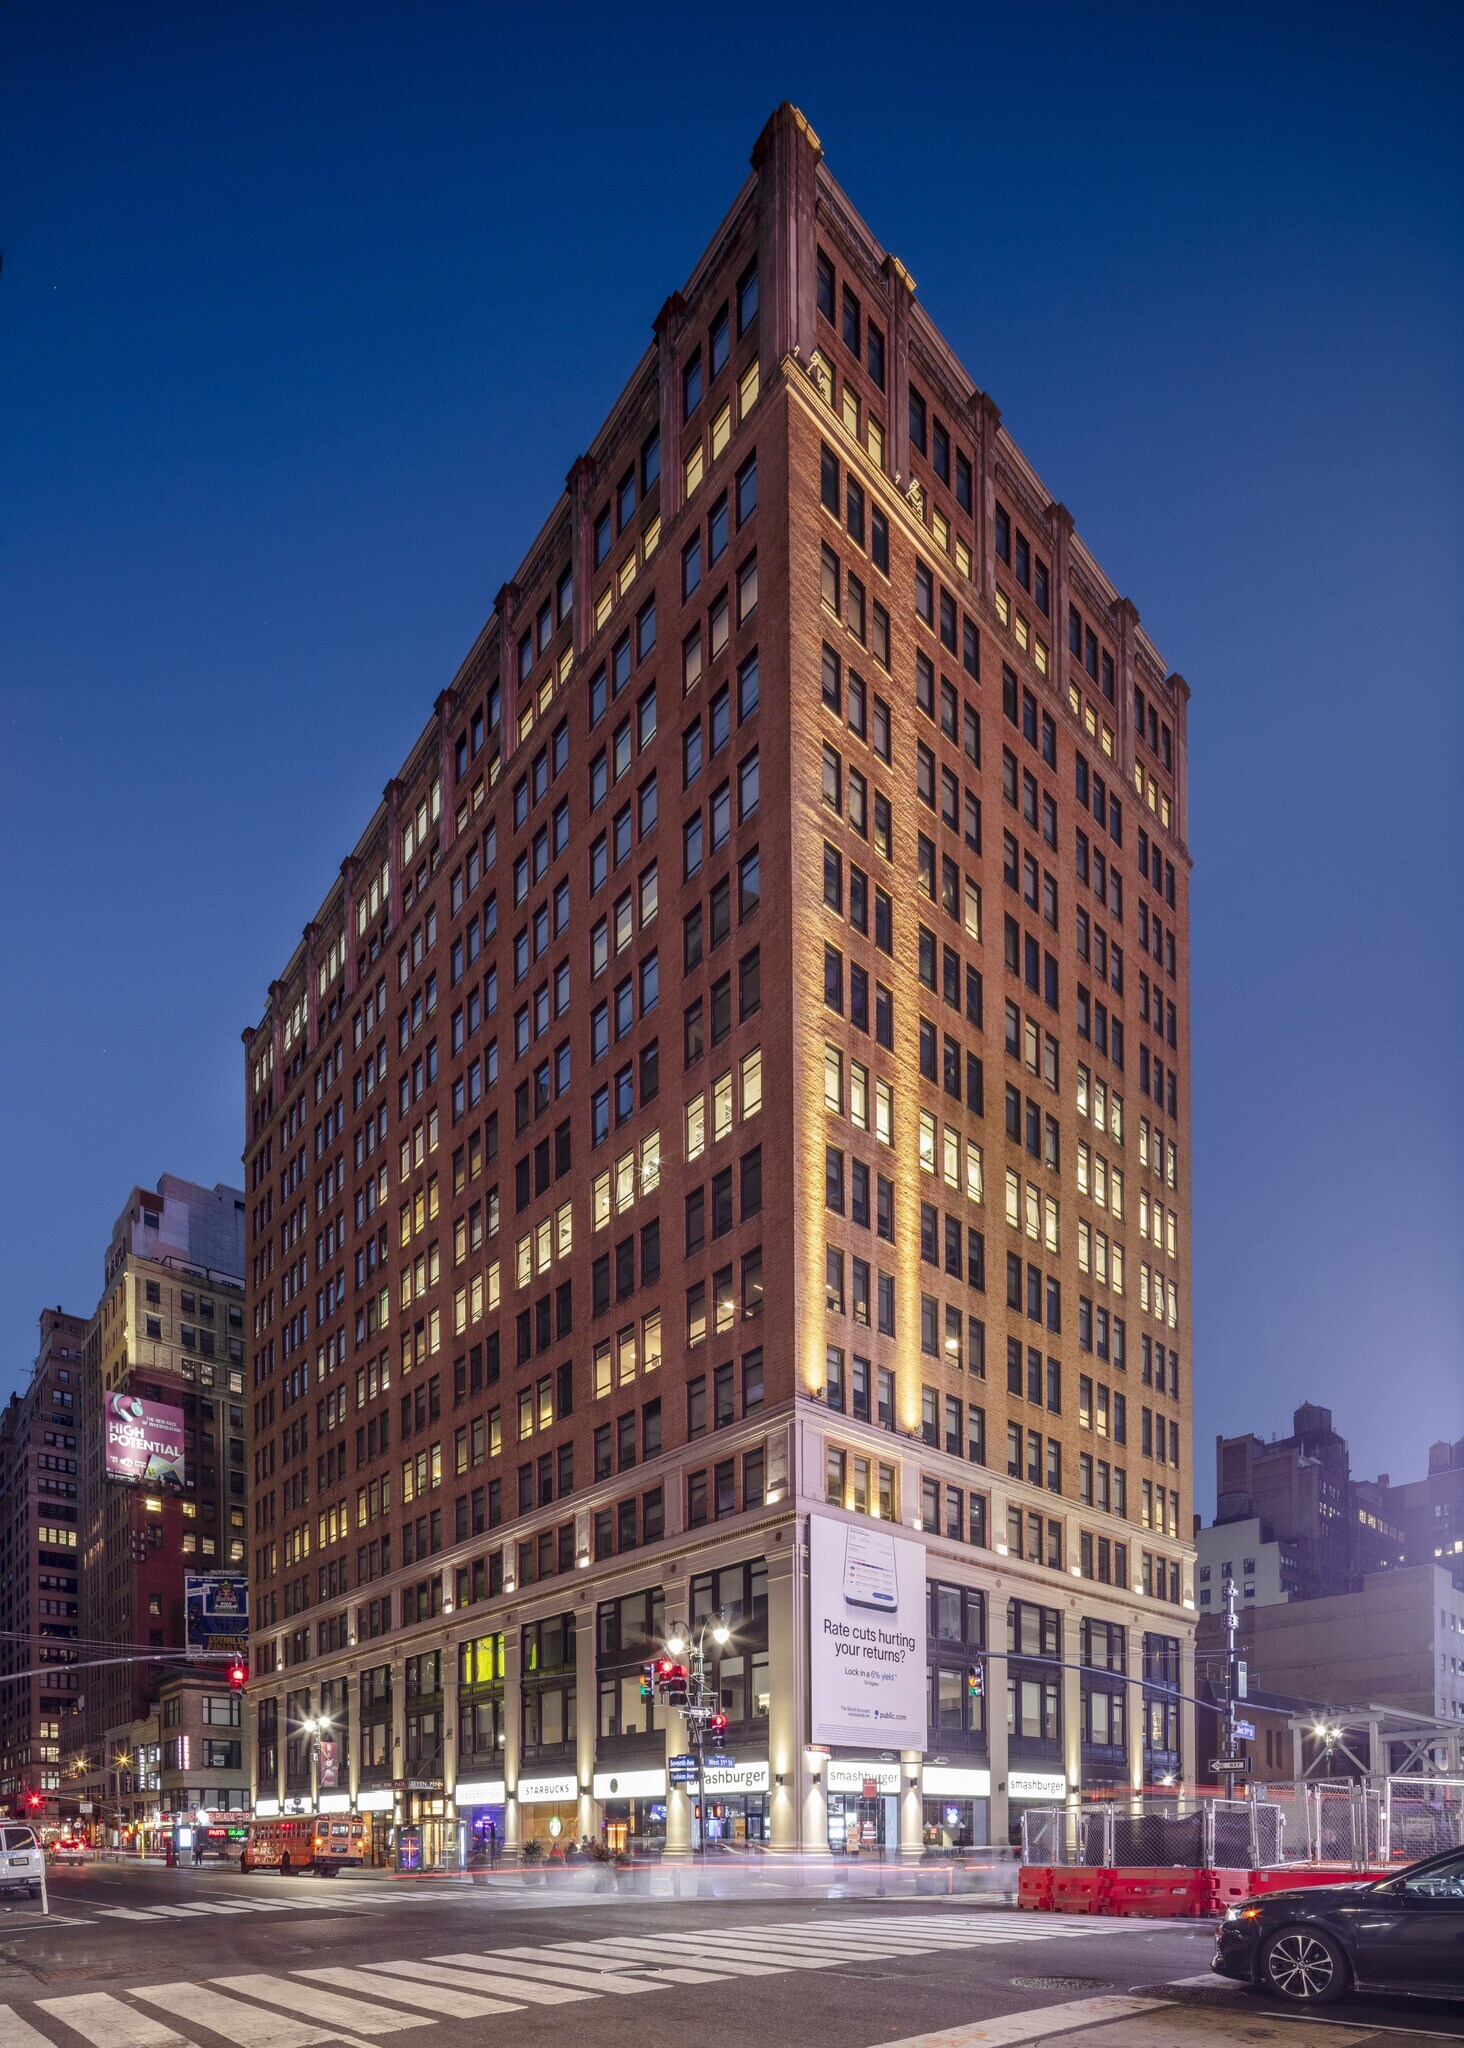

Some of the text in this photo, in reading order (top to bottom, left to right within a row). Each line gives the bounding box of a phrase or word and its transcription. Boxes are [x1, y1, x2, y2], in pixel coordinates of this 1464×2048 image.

[109, 1421, 145, 1439] HIGH
[149, 1422, 181, 1433] INVESTIGATION
[109, 1432, 181, 1457] POTENTIAL
[208, 1635, 245, 1645] WORLD
[824, 1618, 916, 1652] Rate cuts hurting
[207, 1643, 248, 1653] FINALS
[835, 1642, 906, 1663] your returns?
[844, 1667, 860, 1676] Lock
[860, 1669, 866, 1677] in
[870, 1670, 881, 1679] 6%
[879, 1711, 907, 1720] public.com
[830, 1770, 898, 1786] smashburger
[525, 1784, 570, 1795] STARBUCKS
[1010, 1778, 1064, 1794] smashburger
